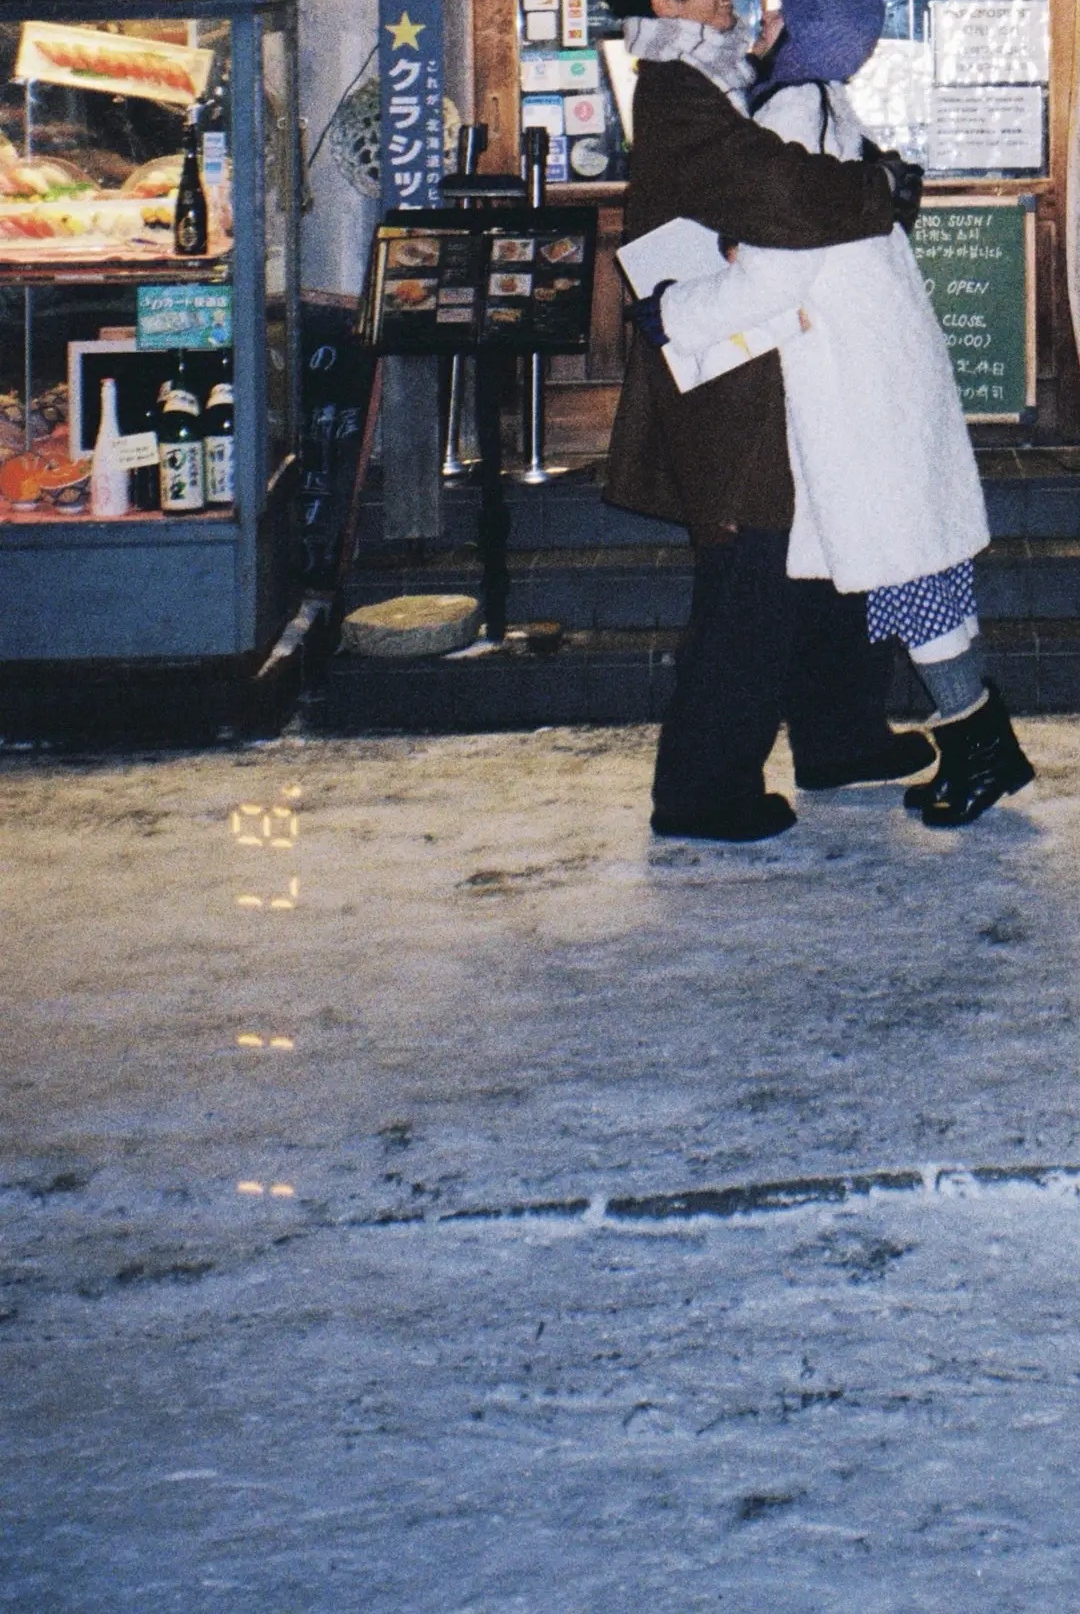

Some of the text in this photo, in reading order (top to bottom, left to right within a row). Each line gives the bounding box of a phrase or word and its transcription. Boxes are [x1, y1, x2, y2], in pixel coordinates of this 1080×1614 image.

[389, 58, 424, 209] クラシッ
[426, 61, 441, 209] これが、北海道のビ
[947, 279, 990, 295] OPEN
